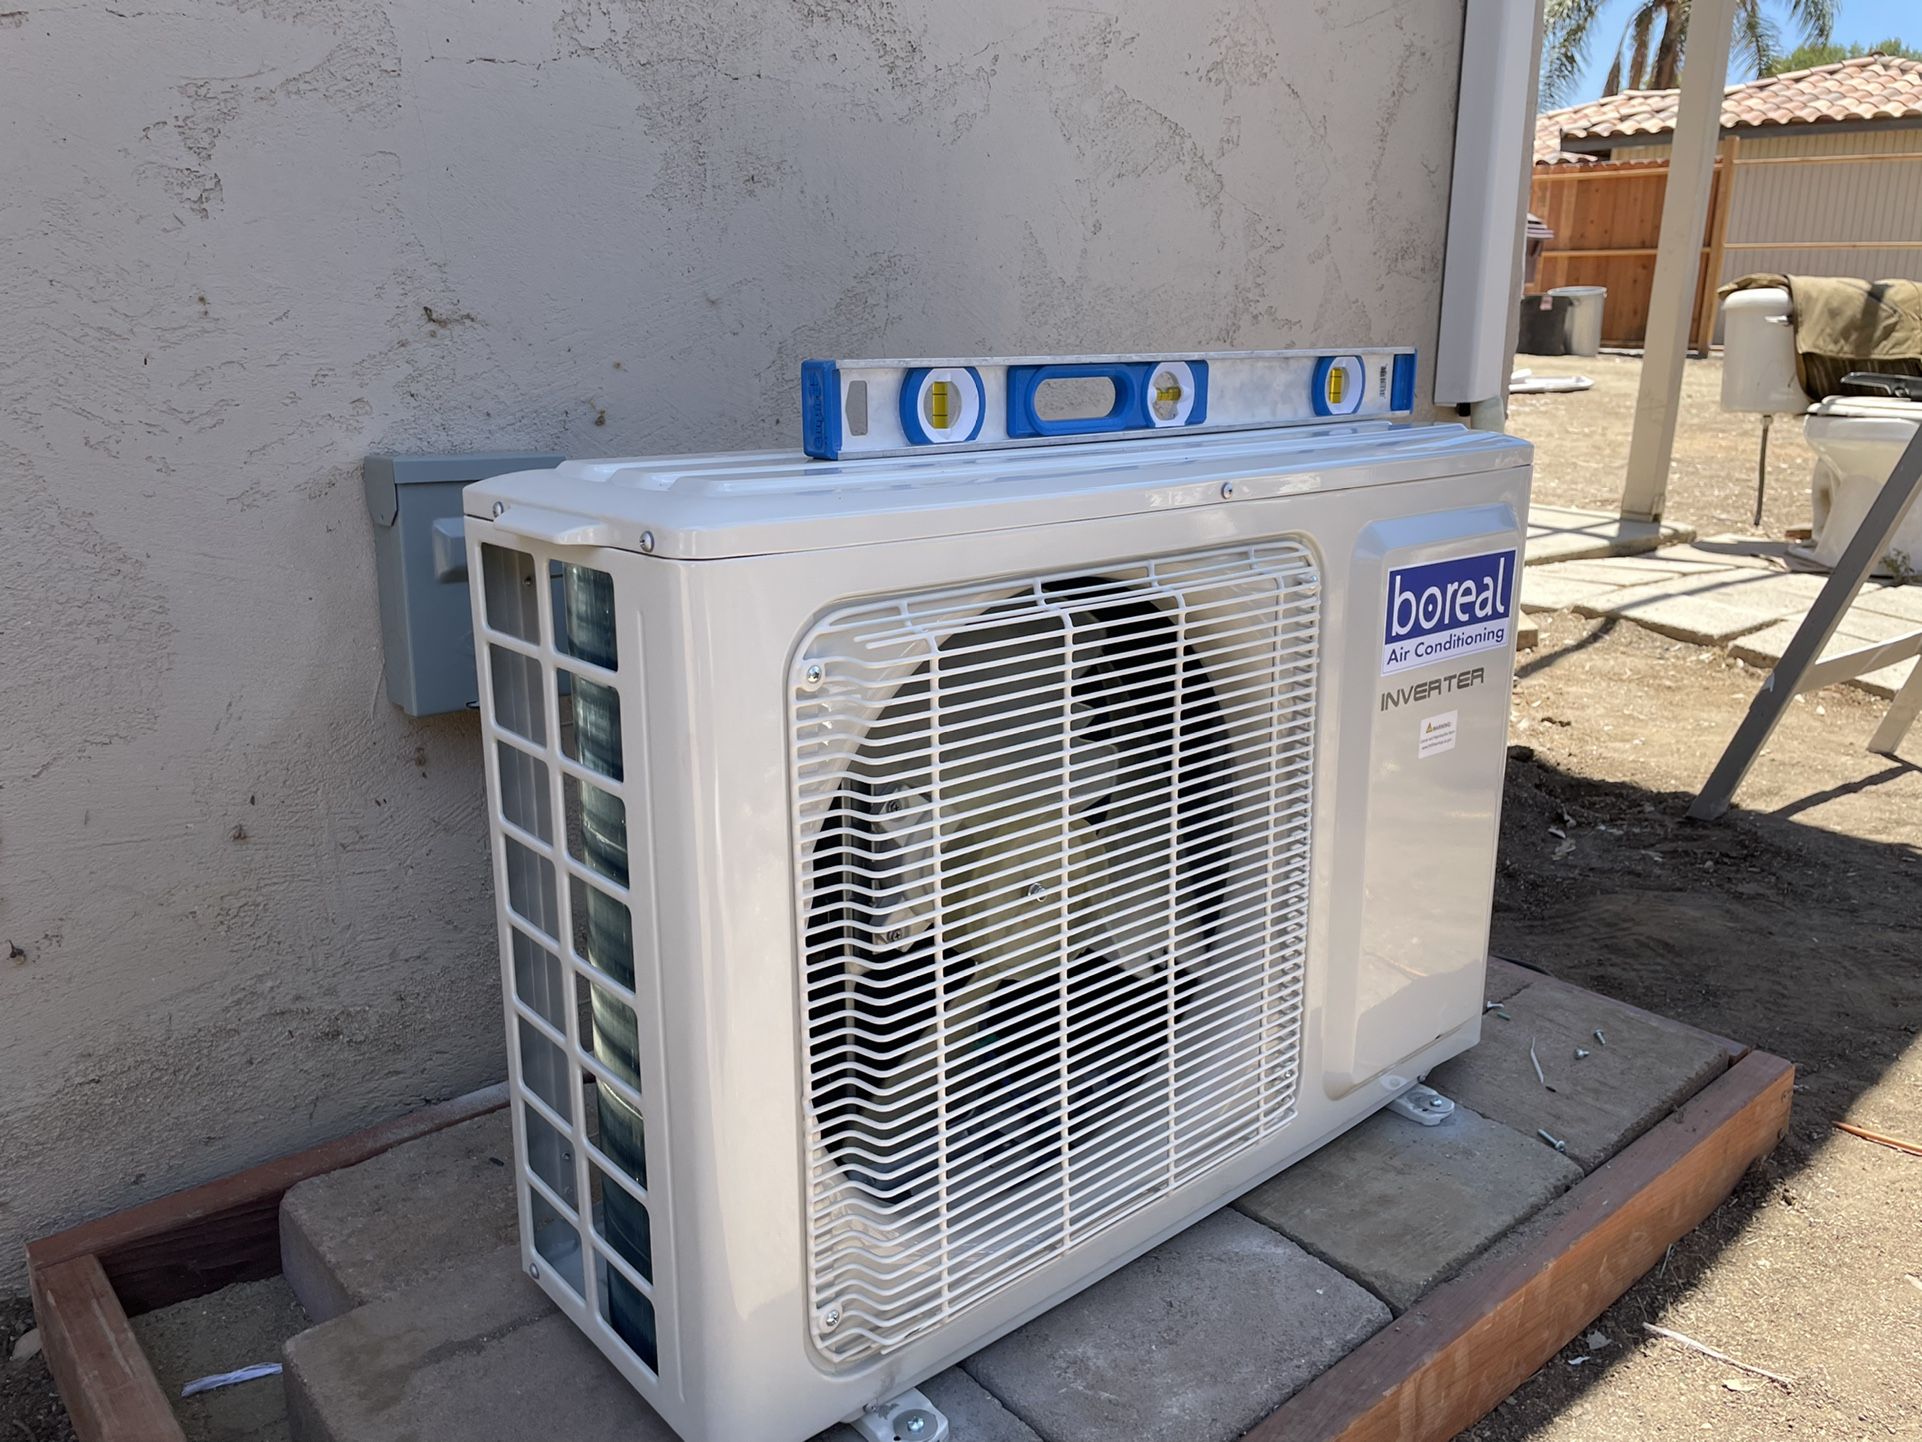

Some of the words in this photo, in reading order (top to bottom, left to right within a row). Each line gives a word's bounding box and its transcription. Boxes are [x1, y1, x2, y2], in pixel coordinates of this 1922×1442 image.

[1391, 557, 1505, 637] boreal
[1386, 646, 1410, 665] Air
[1415, 627, 1505, 658] Conditioning
[1380, 667, 1485, 712] INVERTER
